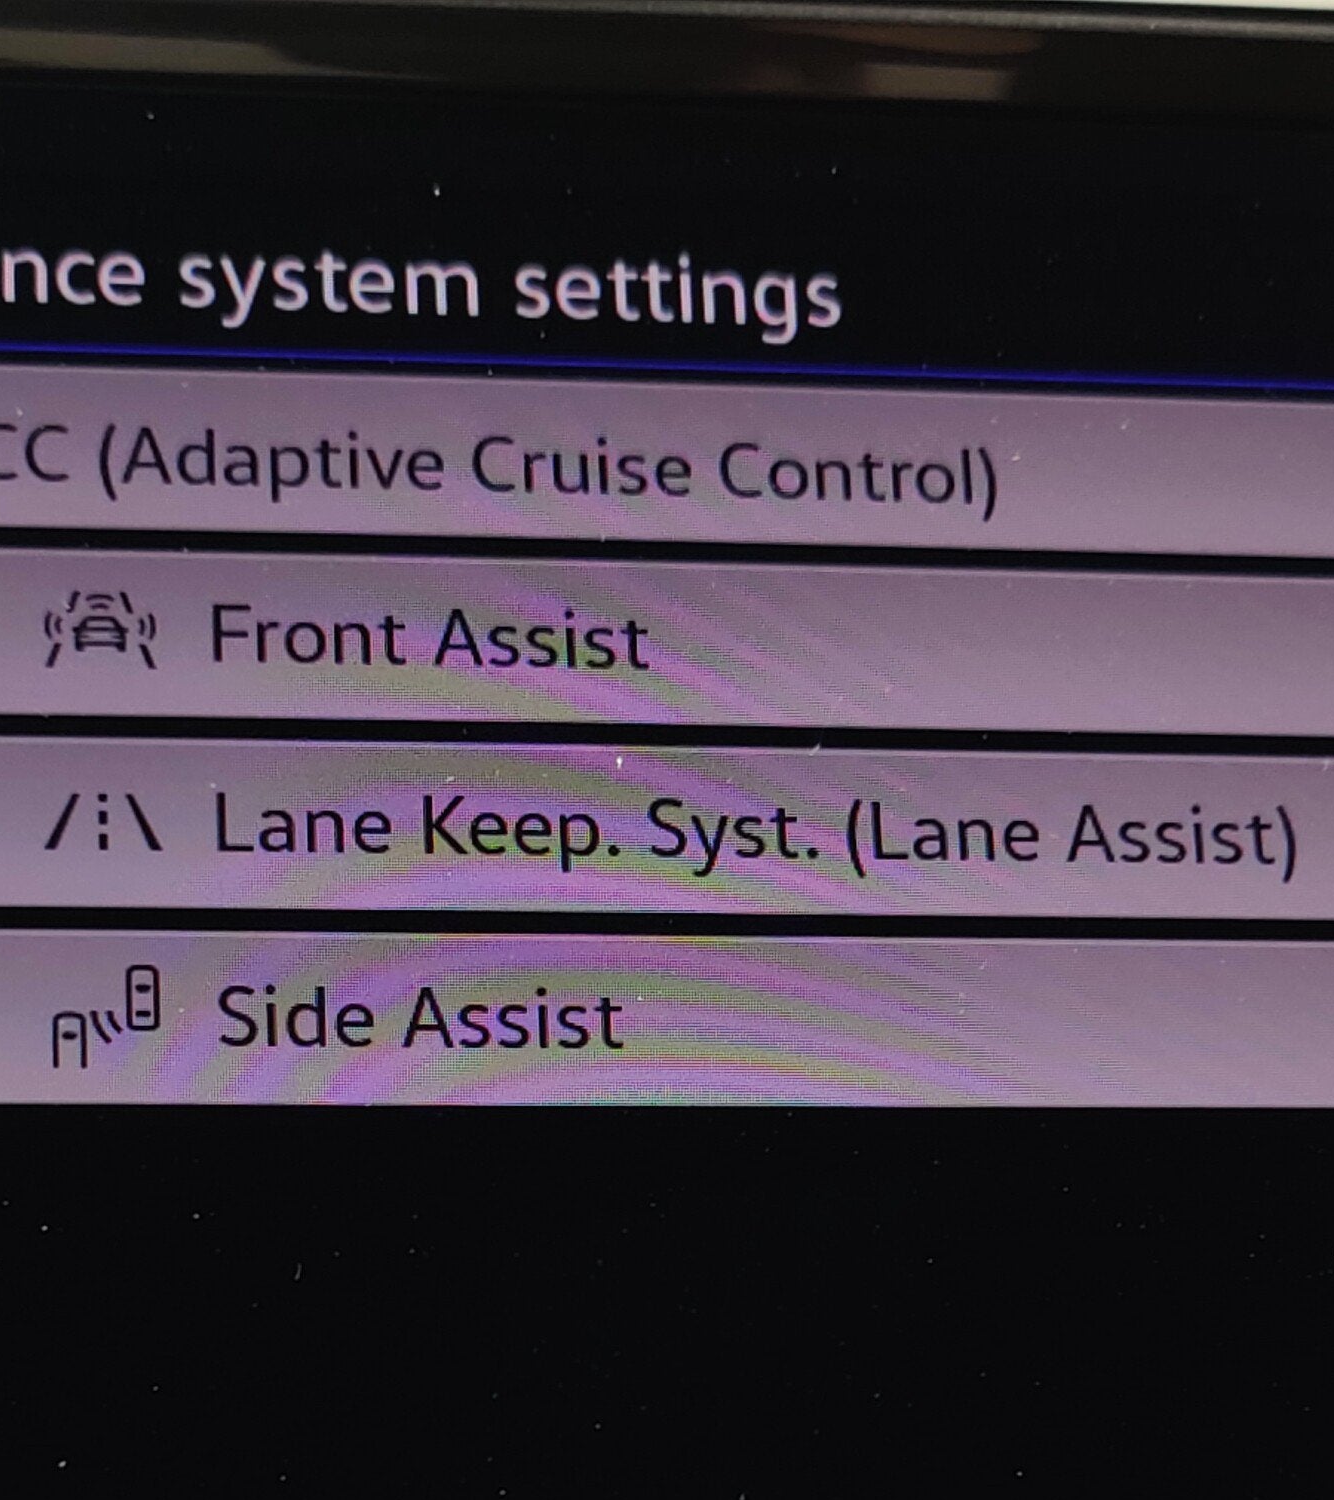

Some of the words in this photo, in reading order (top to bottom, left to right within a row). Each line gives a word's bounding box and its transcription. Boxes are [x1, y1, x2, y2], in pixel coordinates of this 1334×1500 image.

[178, 250, 480, 330] system
[514, 252, 842, 346] settings
[98, 422, 445, 504] (Adaptive
[470, 434, 693, 498] Cruise
[718, 441, 998, 523] Control)
[211, 602, 408, 667] Front
[433, 607, 651, 672] Assist
[214, 790, 393, 855] Lane
[421, 793, 622, 874] Keep.
[645, 796, 822, 879] Syst.
[845, 797, 1041, 880] (Lane
[1065, 803, 1298, 885] Assist)
[216, 982, 376, 1049] Side
[400, 985, 625, 1051] Assist
